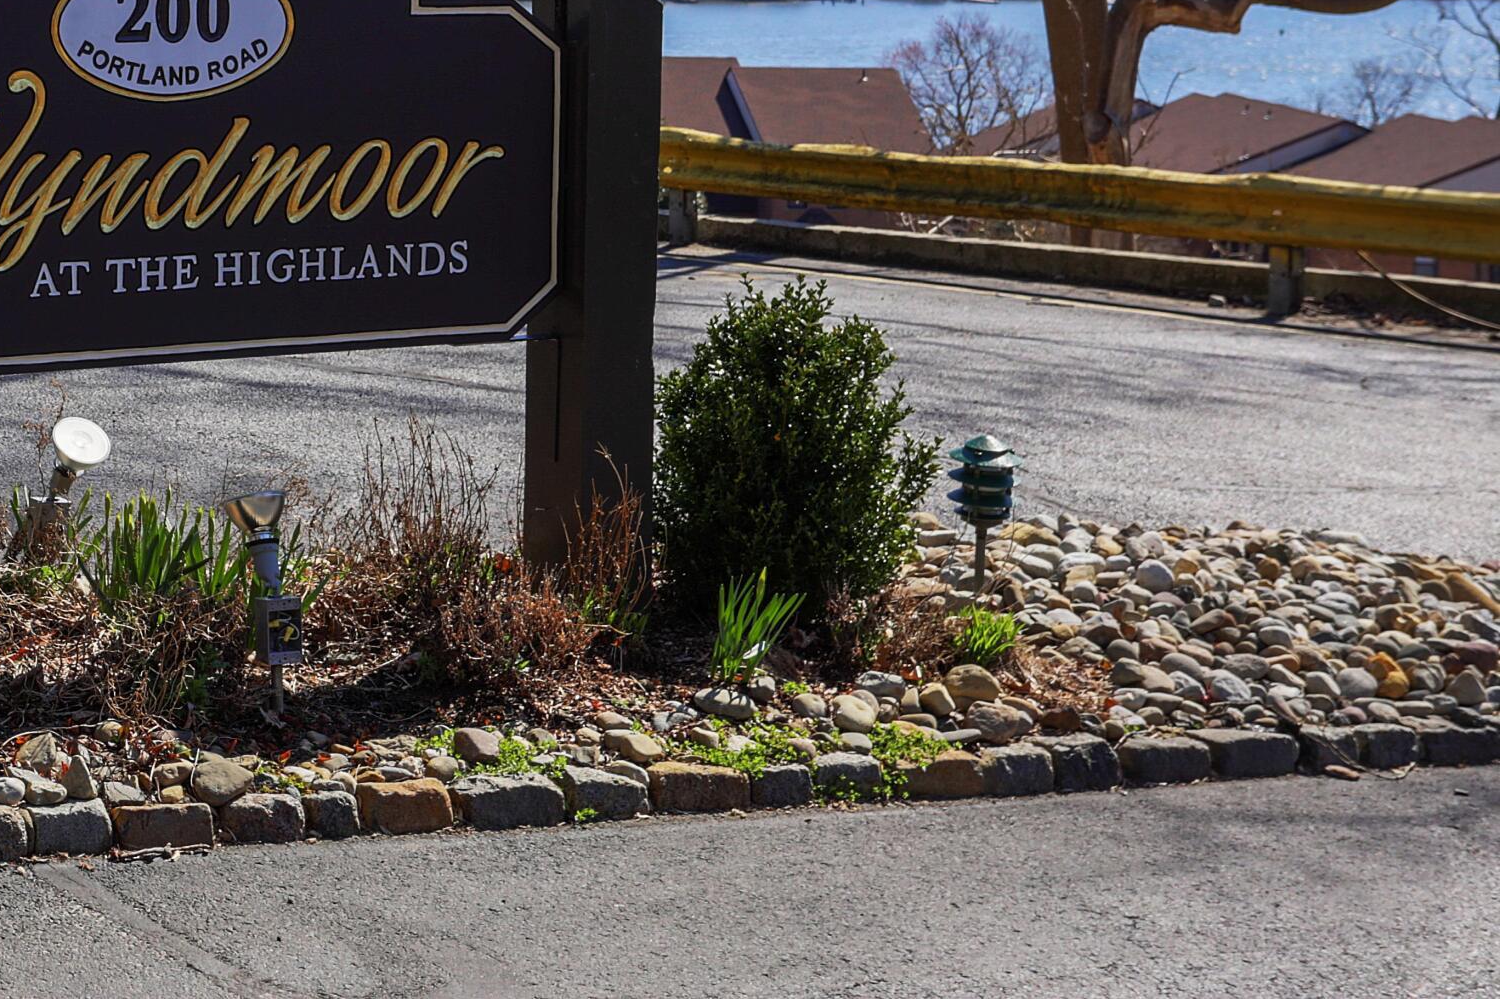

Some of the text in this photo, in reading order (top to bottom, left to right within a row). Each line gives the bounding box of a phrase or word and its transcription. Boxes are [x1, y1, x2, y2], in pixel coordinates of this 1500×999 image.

[77, 37, 269, 86] PORTLAND ROAD
[30, 240, 468, 298] AT THE HIGHLANDS
